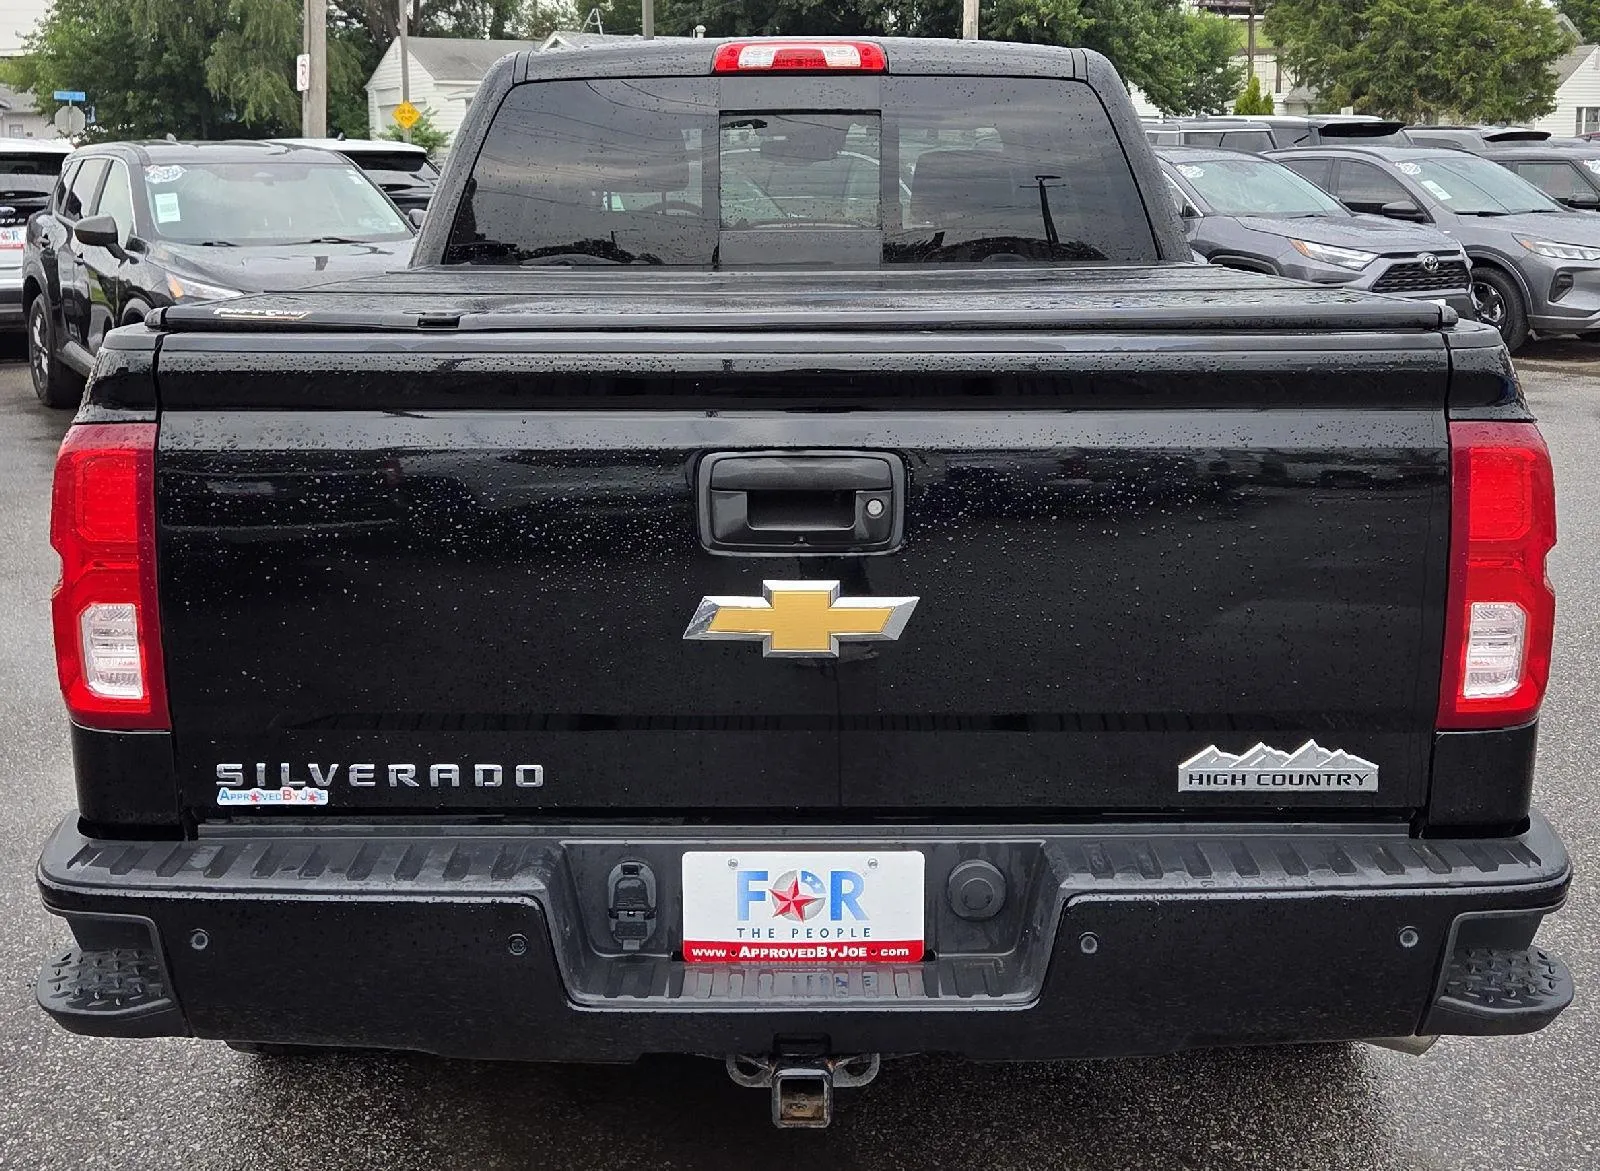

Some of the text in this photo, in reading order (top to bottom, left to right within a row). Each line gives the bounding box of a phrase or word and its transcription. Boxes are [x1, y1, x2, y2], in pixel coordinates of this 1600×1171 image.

[216, 763, 544, 787] SILVERADO
[1188, 773, 1369, 786] HIGH COUNTRY
[736, 870, 870, 922] FOR
[736, 928, 871, 939] THE PEOPLE
